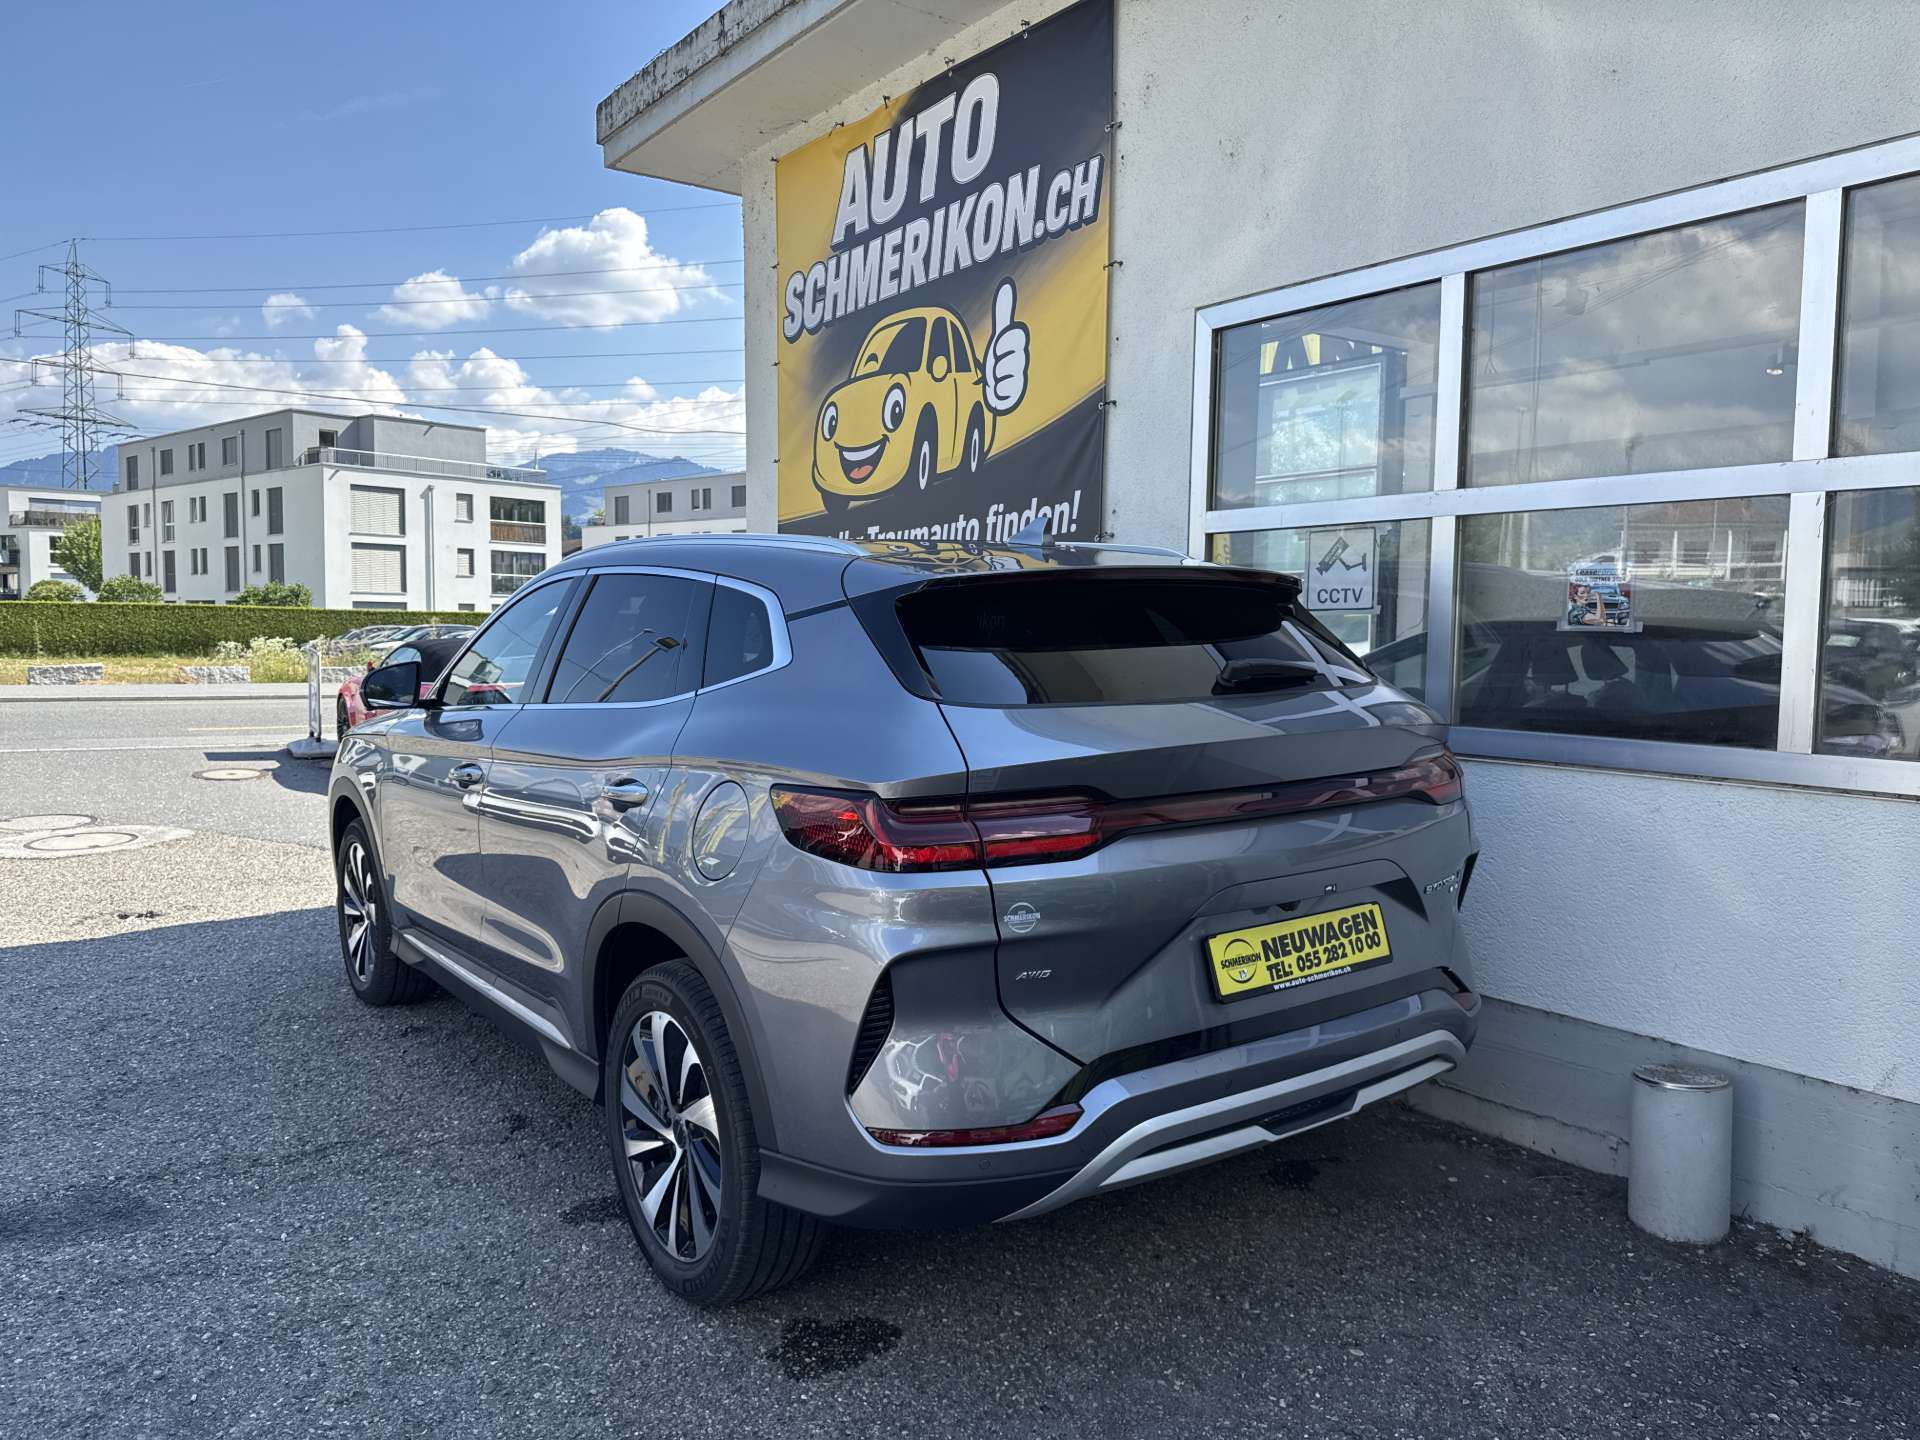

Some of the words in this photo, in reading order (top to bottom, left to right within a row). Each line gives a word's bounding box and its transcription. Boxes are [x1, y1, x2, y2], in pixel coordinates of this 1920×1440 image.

[831, 72, 1000, 249] AUTO
[783, 153, 1104, 339] SCHMERIKON.CH
[1316, 587, 1364, 604] CCTV
[1220, 951, 1262, 970] SCHMERIKON
[1260, 909, 1378, 962] NEUWAGEN
[1266, 961, 1294, 981] TEL:
[1296, 949, 1322, 973] 055
[1323, 941, 1348, 965] 282
[1348, 936, 1365, 955] 10
[1364, 930, 1381, 950] 00
[1273, 966, 1352, 991] www.auto-schmerikon.ch
